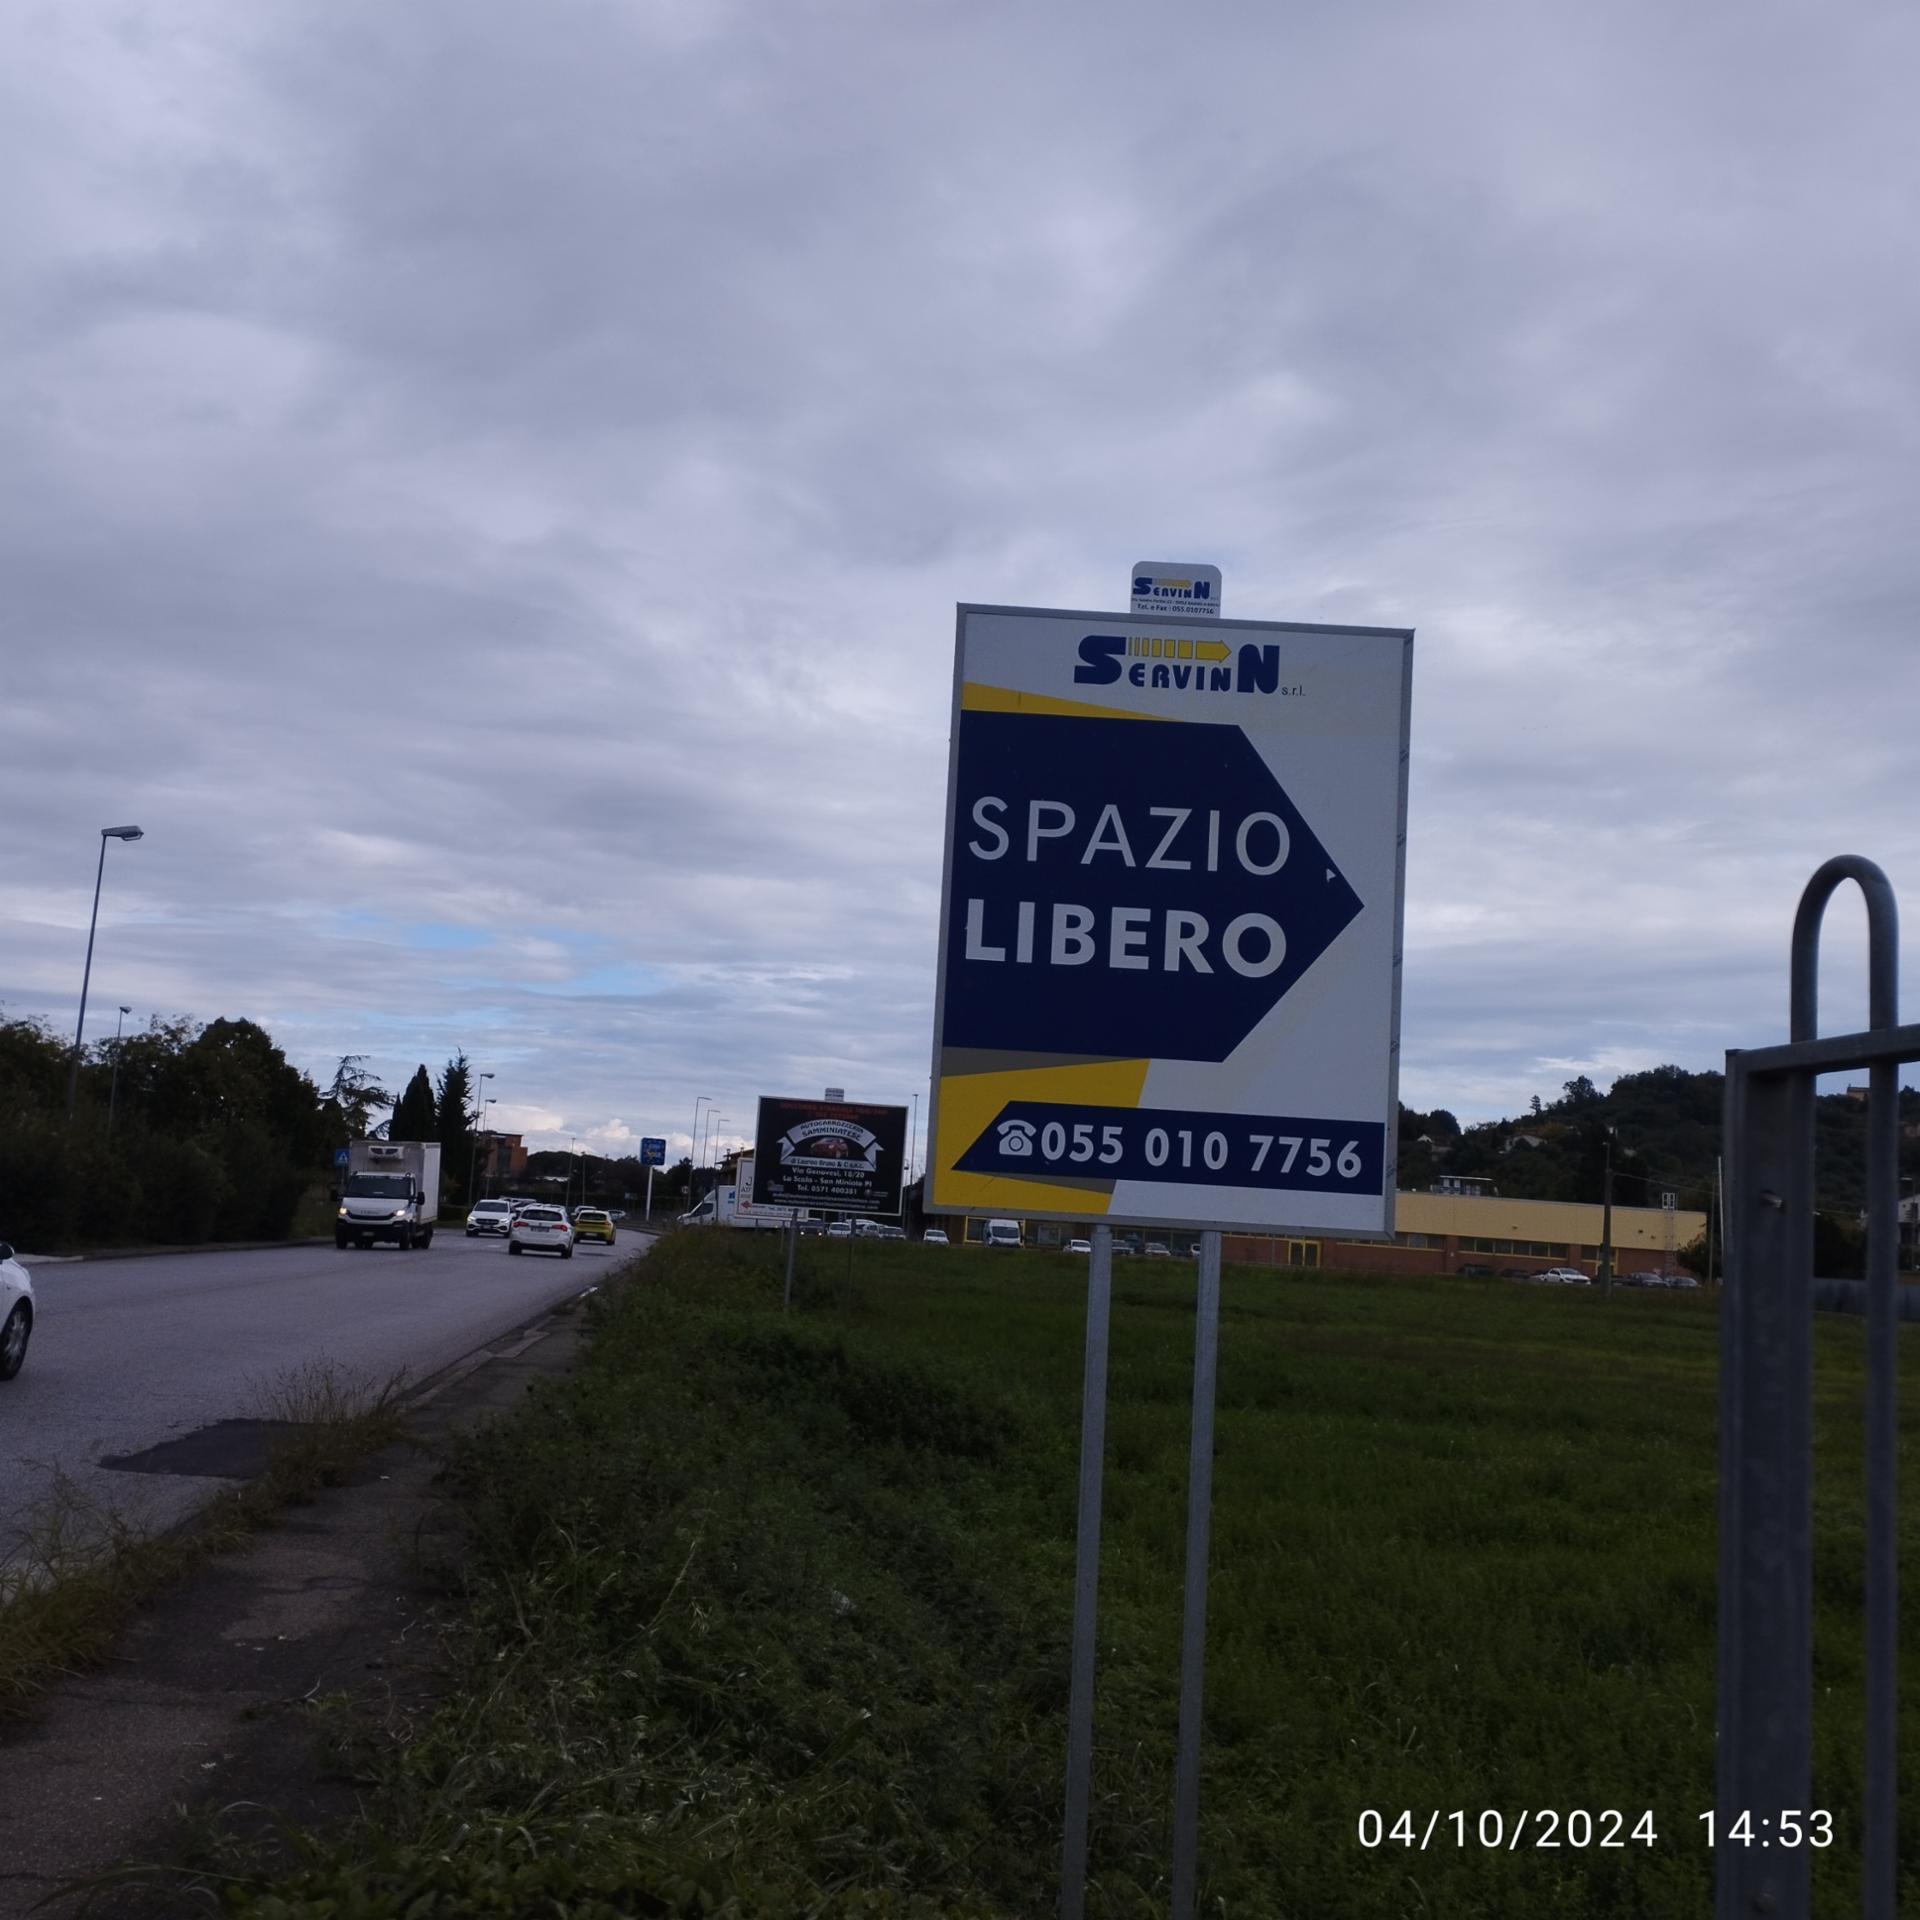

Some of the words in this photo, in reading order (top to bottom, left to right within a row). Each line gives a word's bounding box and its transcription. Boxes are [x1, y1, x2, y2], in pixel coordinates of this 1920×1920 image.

[1281, 685, 1306, 697] s.r.l.
[969, 796, 1290, 876] SPAZIO
[965, 898, 1287, 978] LIBERO
[801, 1126, 862, 1141] SAMMINIATESE
[1041, 1121, 1124, 1164] 055
[1145, 1128, 1228, 1170] 010
[1249, 1135, 1362, 1178] 7756
[792, 1166, 805, 1174] Via
[820, 1177, 834, 1185] San
[797, 1184, 810, 1192] Tel.
[811, 1185, 828, 1193] 0571
